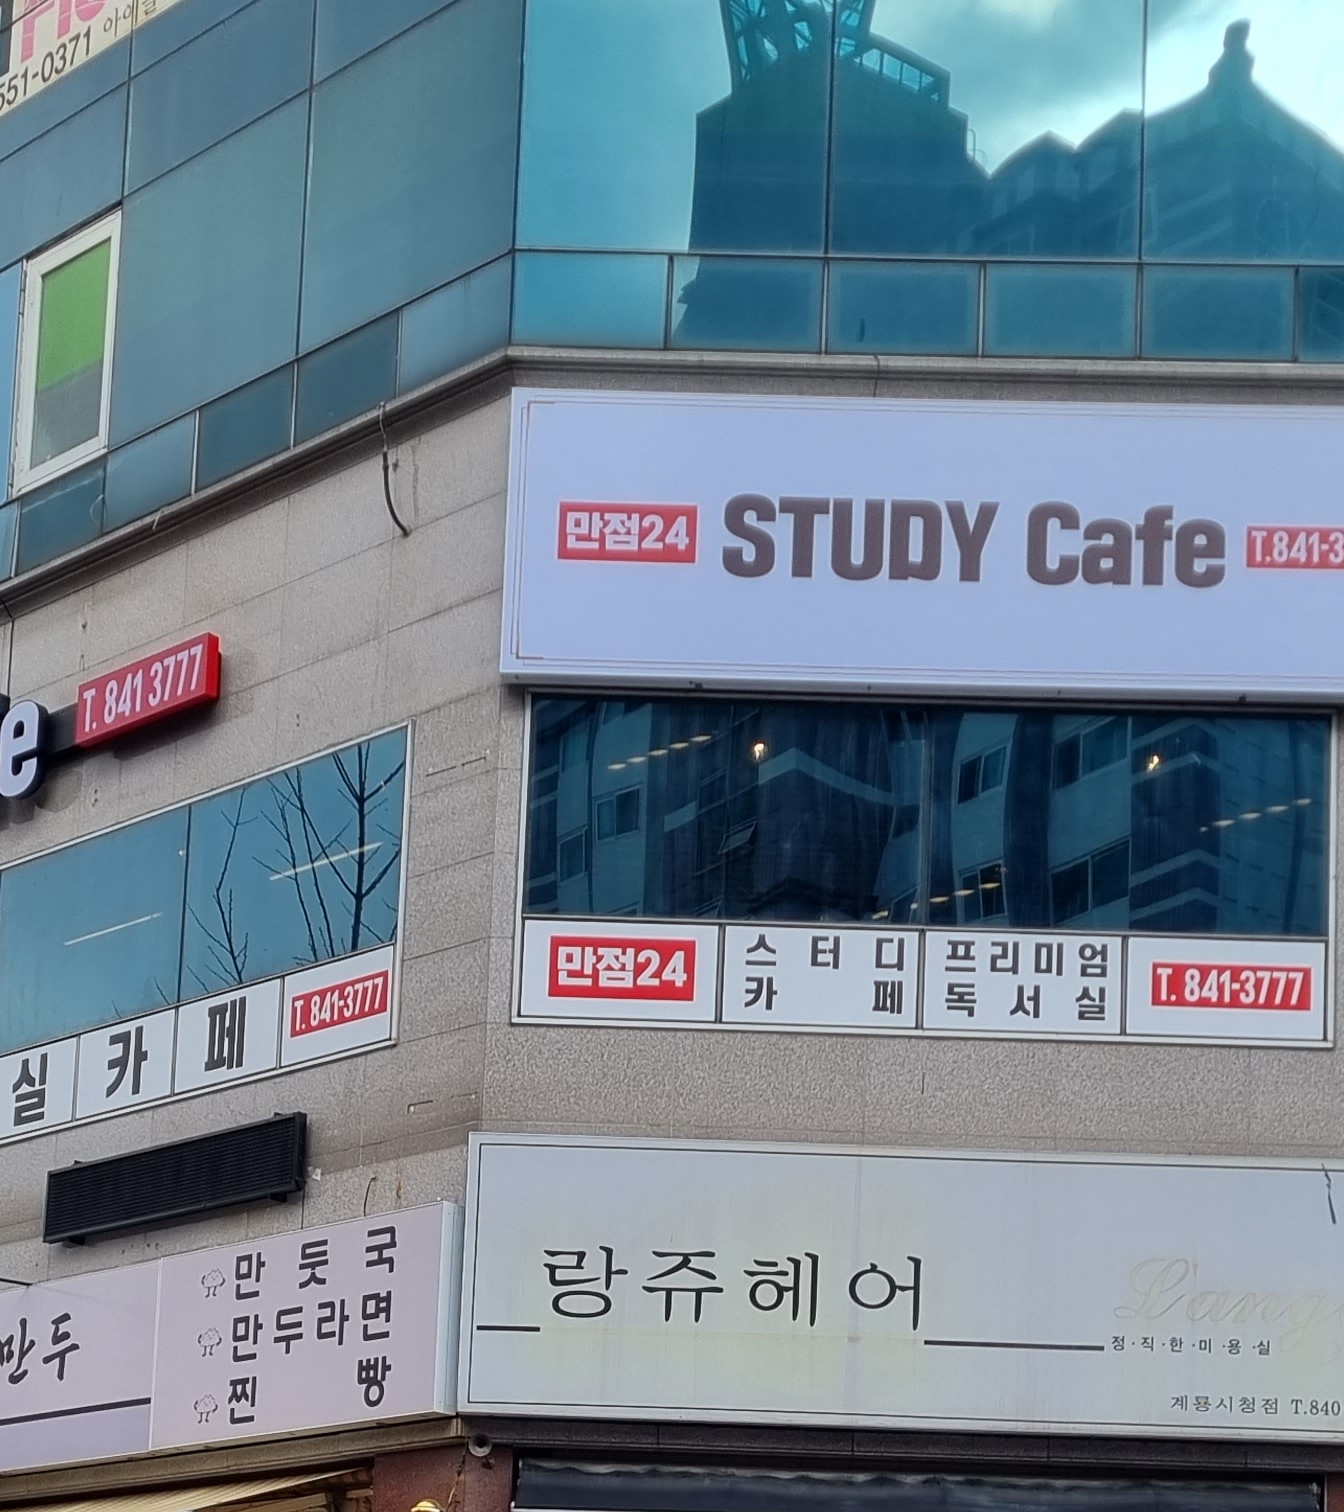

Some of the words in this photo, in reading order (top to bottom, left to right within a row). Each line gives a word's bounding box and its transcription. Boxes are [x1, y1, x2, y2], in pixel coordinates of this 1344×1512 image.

[565, 510, 691, 554] 만점24
[721, 492, 1000, 582] STUDY
[1024, 500, 1227, 588] Cafe
[556, 945, 689, 990] 만점24
[745, 932, 906, 972] 스터디
[944, 940, 1109, 979] 프리미엄
[743, 977, 904, 1015] 카페
[944, 982, 1108, 1022] 독서실
[233, 1225, 398, 1300] 만둣국
[541, 1244, 925, 1332] 랑쥬헤어
[230, 1290, 392, 1363] 만두라면
[226, 1355, 391, 1426] 찐빵
[1170, 1393, 1279, 1416] 계룡시청점
